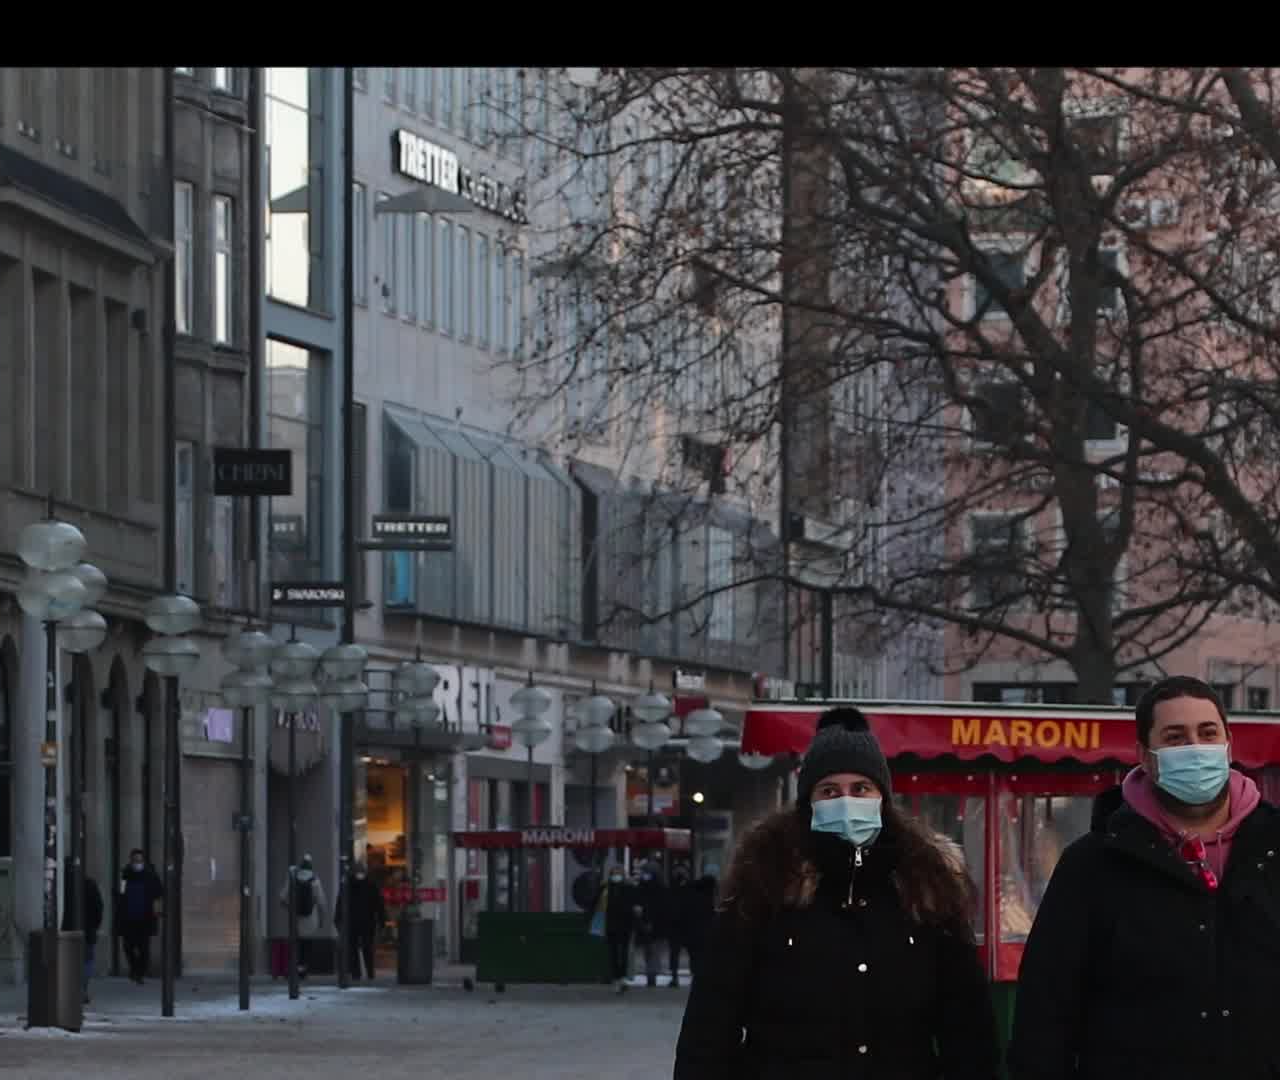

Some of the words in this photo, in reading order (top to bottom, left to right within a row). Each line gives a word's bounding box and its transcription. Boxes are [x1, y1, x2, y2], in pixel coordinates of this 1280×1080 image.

[399, 129, 458, 194] TRETTER
[951, 718, 1101, 749] MARONI
[521, 828, 596, 847] MARONI
